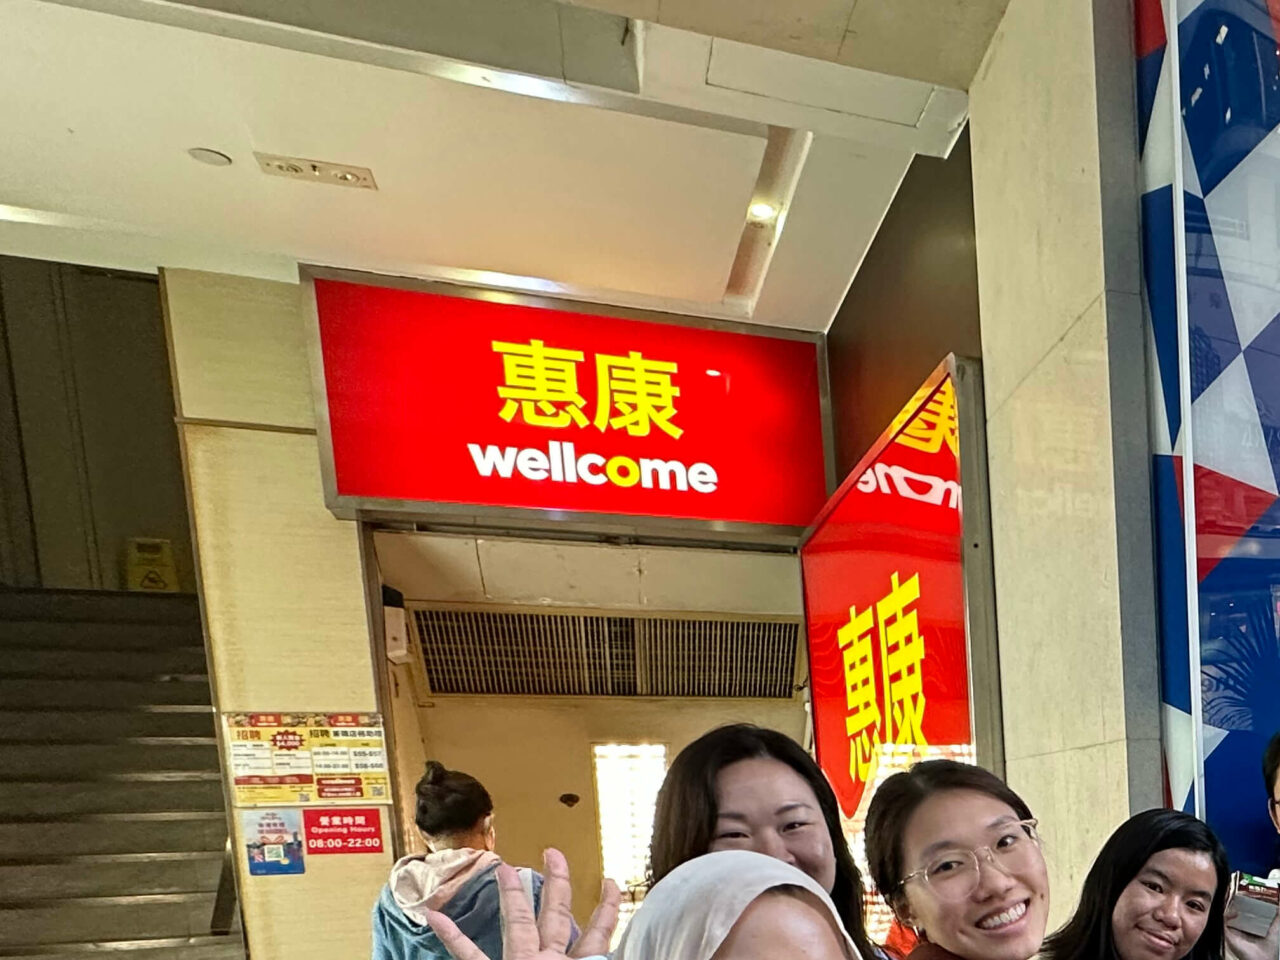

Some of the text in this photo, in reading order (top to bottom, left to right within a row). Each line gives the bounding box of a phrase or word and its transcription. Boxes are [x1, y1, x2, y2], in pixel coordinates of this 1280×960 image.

[491, 339, 684, 440] 惠康
[467, 440, 718, 493] wellcome
[838, 571, 927, 784] 惠康
[309, 838, 380, 848] 08:00-22:00
[311, 826, 348, 834] Opening
